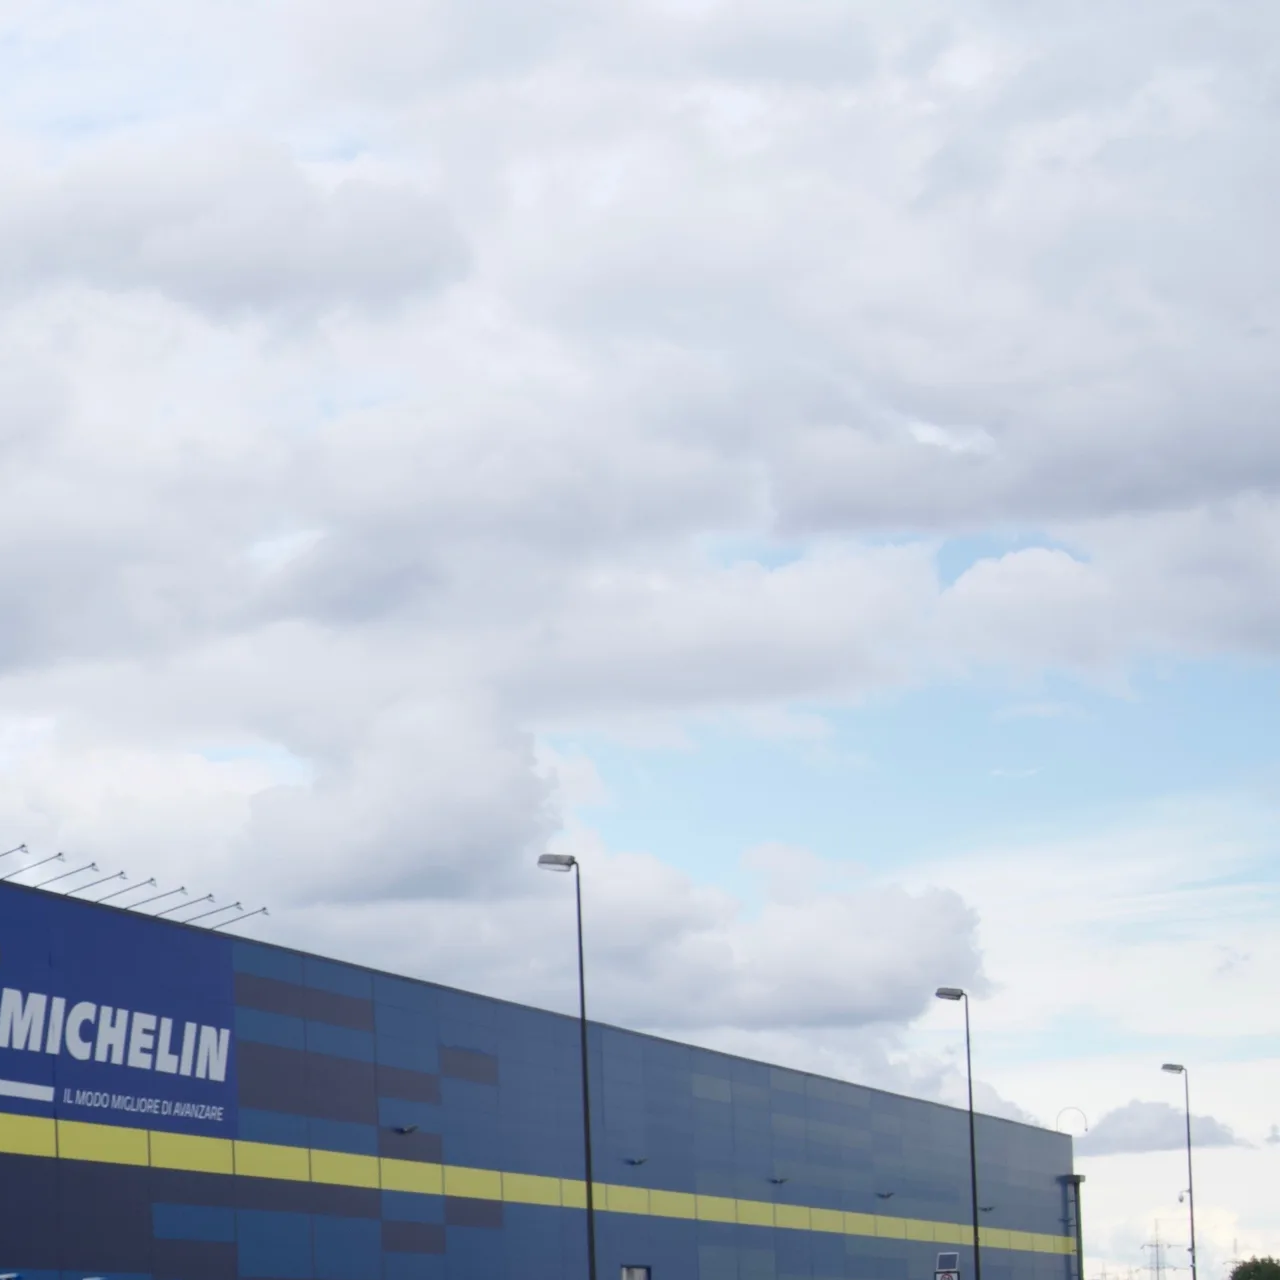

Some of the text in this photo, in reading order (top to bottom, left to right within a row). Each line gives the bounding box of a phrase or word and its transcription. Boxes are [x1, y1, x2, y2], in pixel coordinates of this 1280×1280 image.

[62, 1087, 225, 1122] IL MODO MIGLIORE DI AVANZARE
